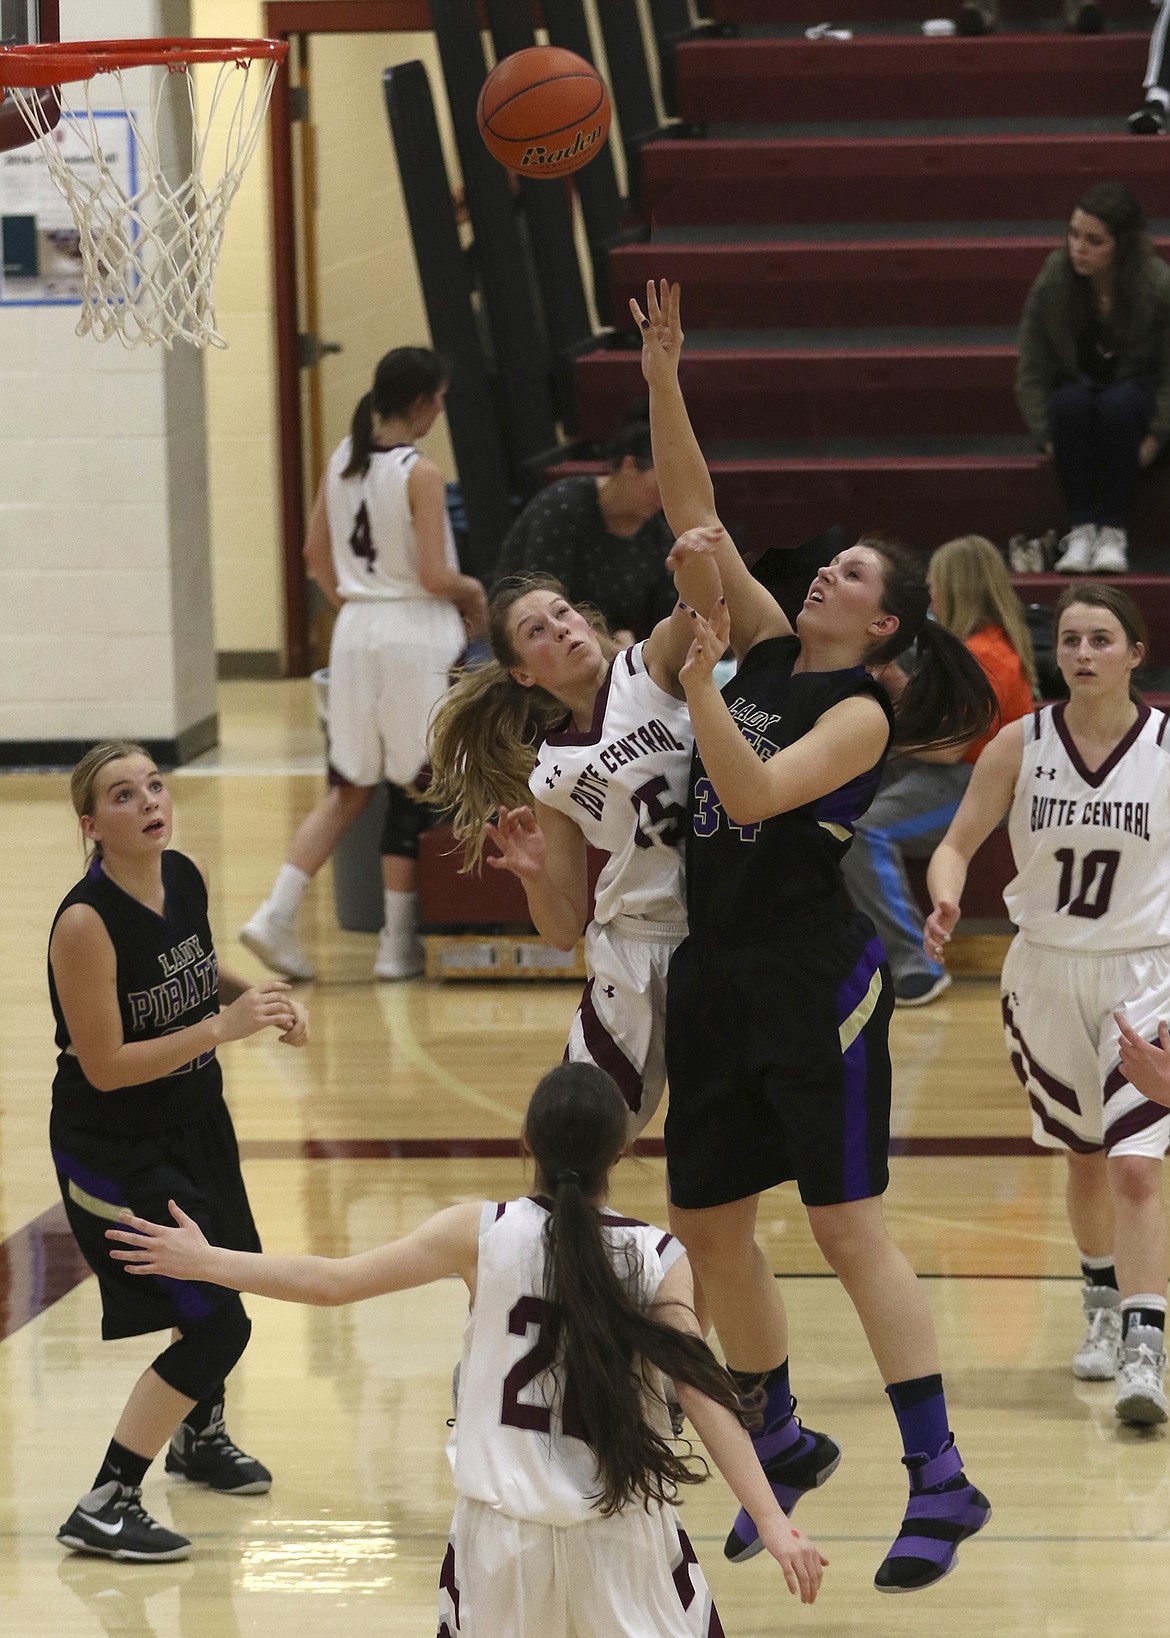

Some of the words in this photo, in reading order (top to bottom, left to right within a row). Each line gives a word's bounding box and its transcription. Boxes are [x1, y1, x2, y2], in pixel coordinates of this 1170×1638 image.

[521, 124, 602, 165] Baden
[348, 498, 377, 573] 4
[728, 697, 782, 732] LADY
[571, 763, 608, 821] BUTTE
[600, 719, 685, 773] CENTRAL
[1031, 795, 1077, 832] BUTTE
[1081, 802, 1150, 841] CENTRAL
[1054, 848, 1121, 919] 10
[158, 934, 204, 977] LADY
